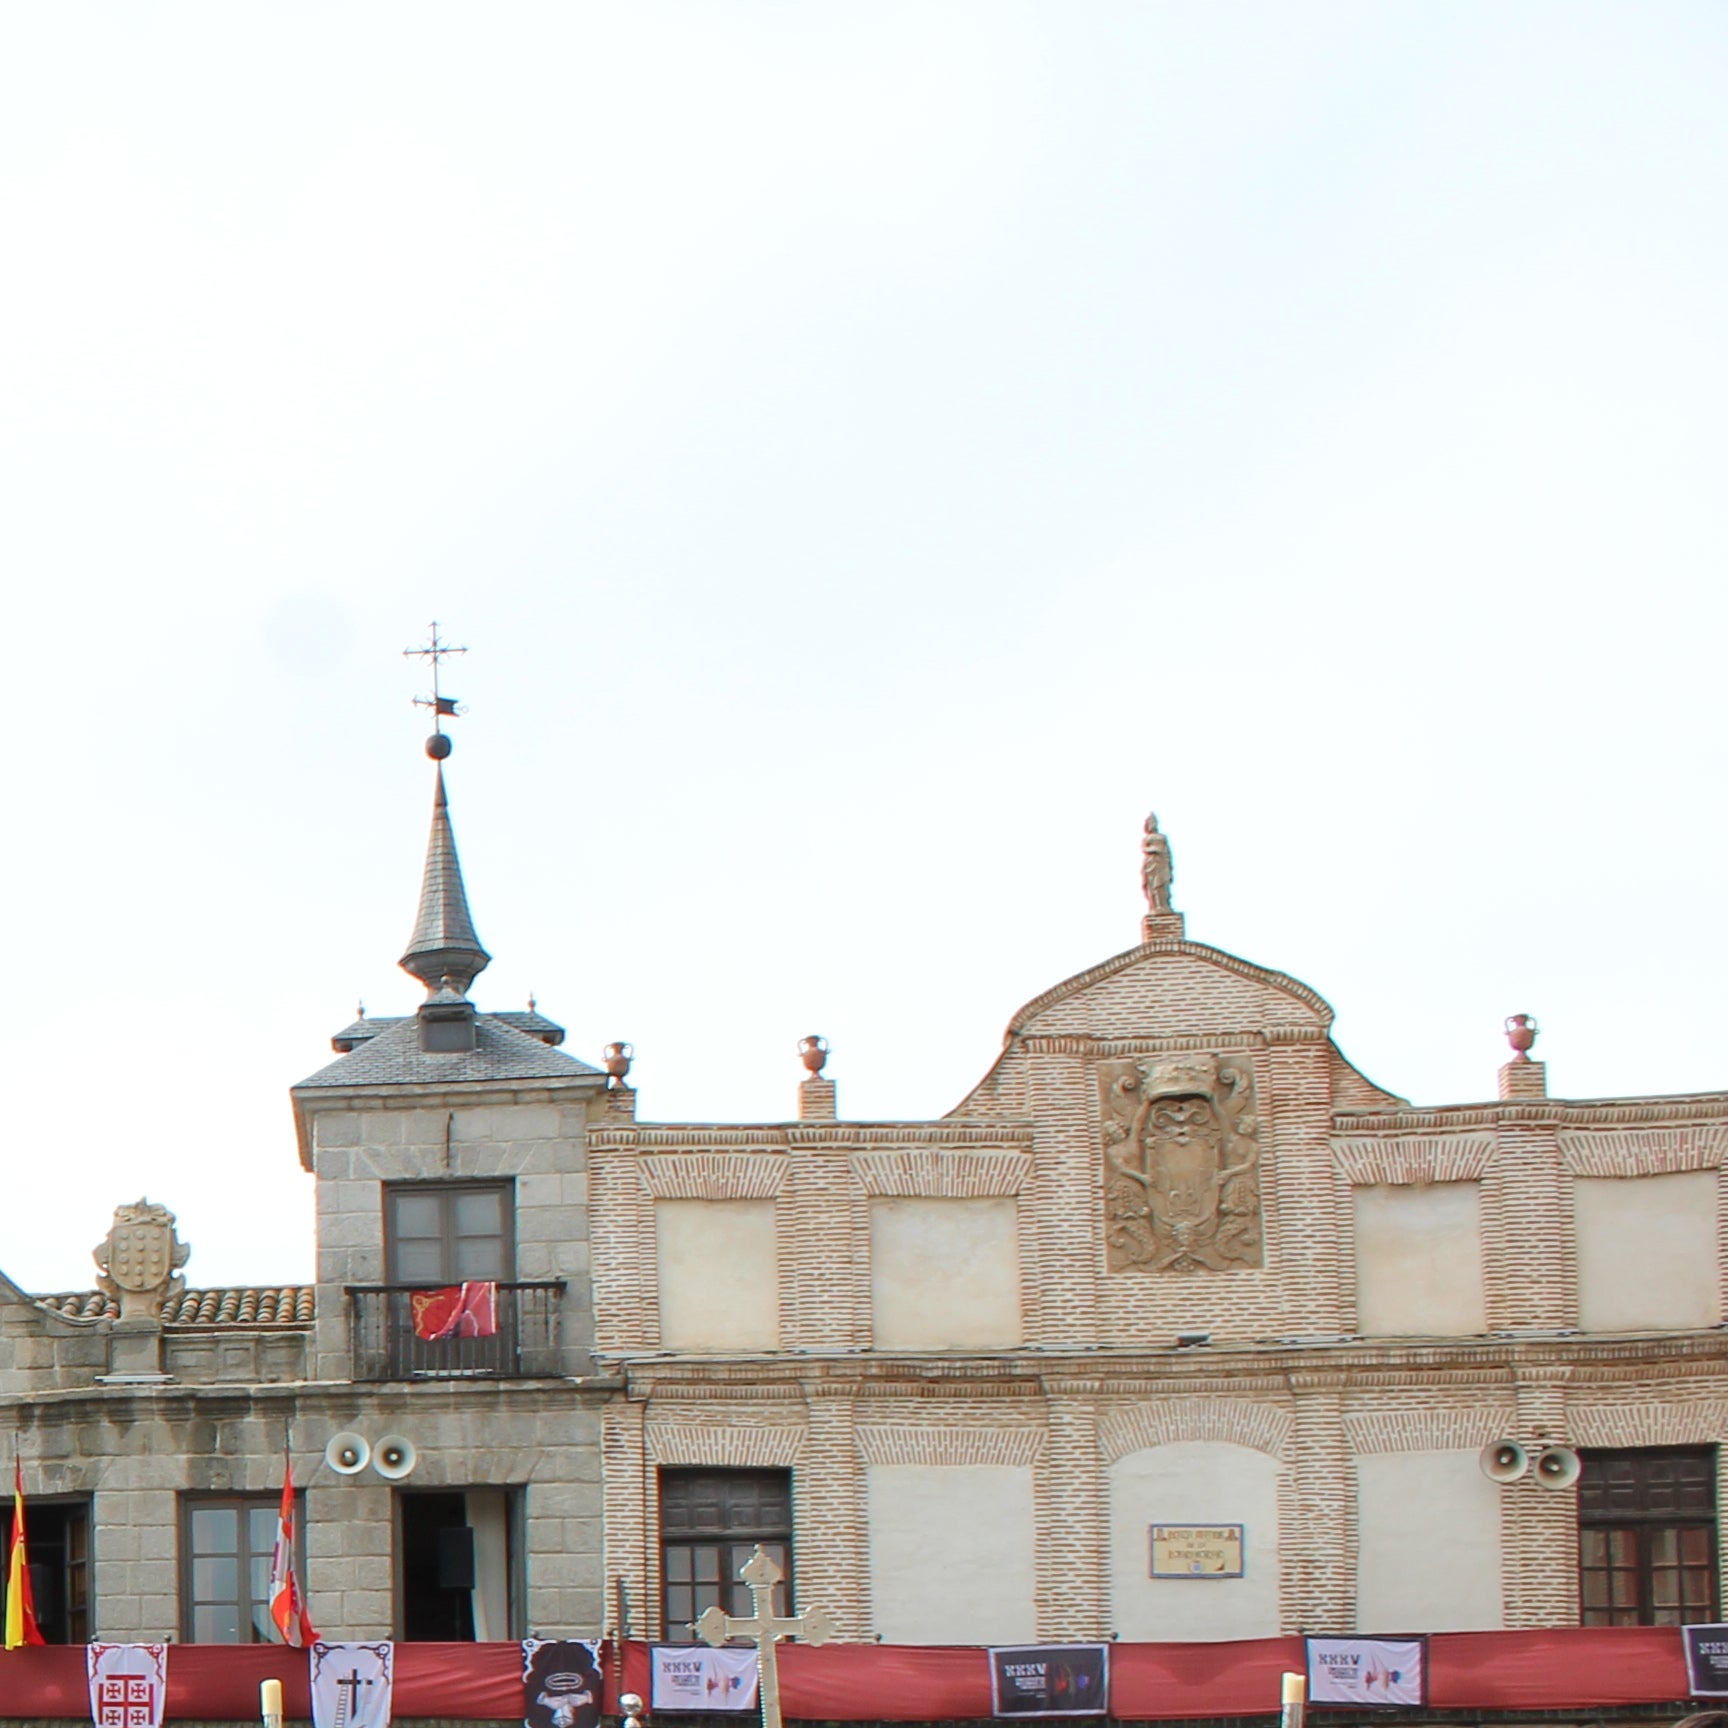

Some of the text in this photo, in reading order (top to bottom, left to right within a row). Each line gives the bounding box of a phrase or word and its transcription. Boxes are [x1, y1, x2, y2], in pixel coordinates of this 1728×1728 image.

[1318, 1654, 1361, 1665] XXXV
[662, 1661, 703, 1673] XXXV
[1004, 1663, 1046, 1677] XXXV
